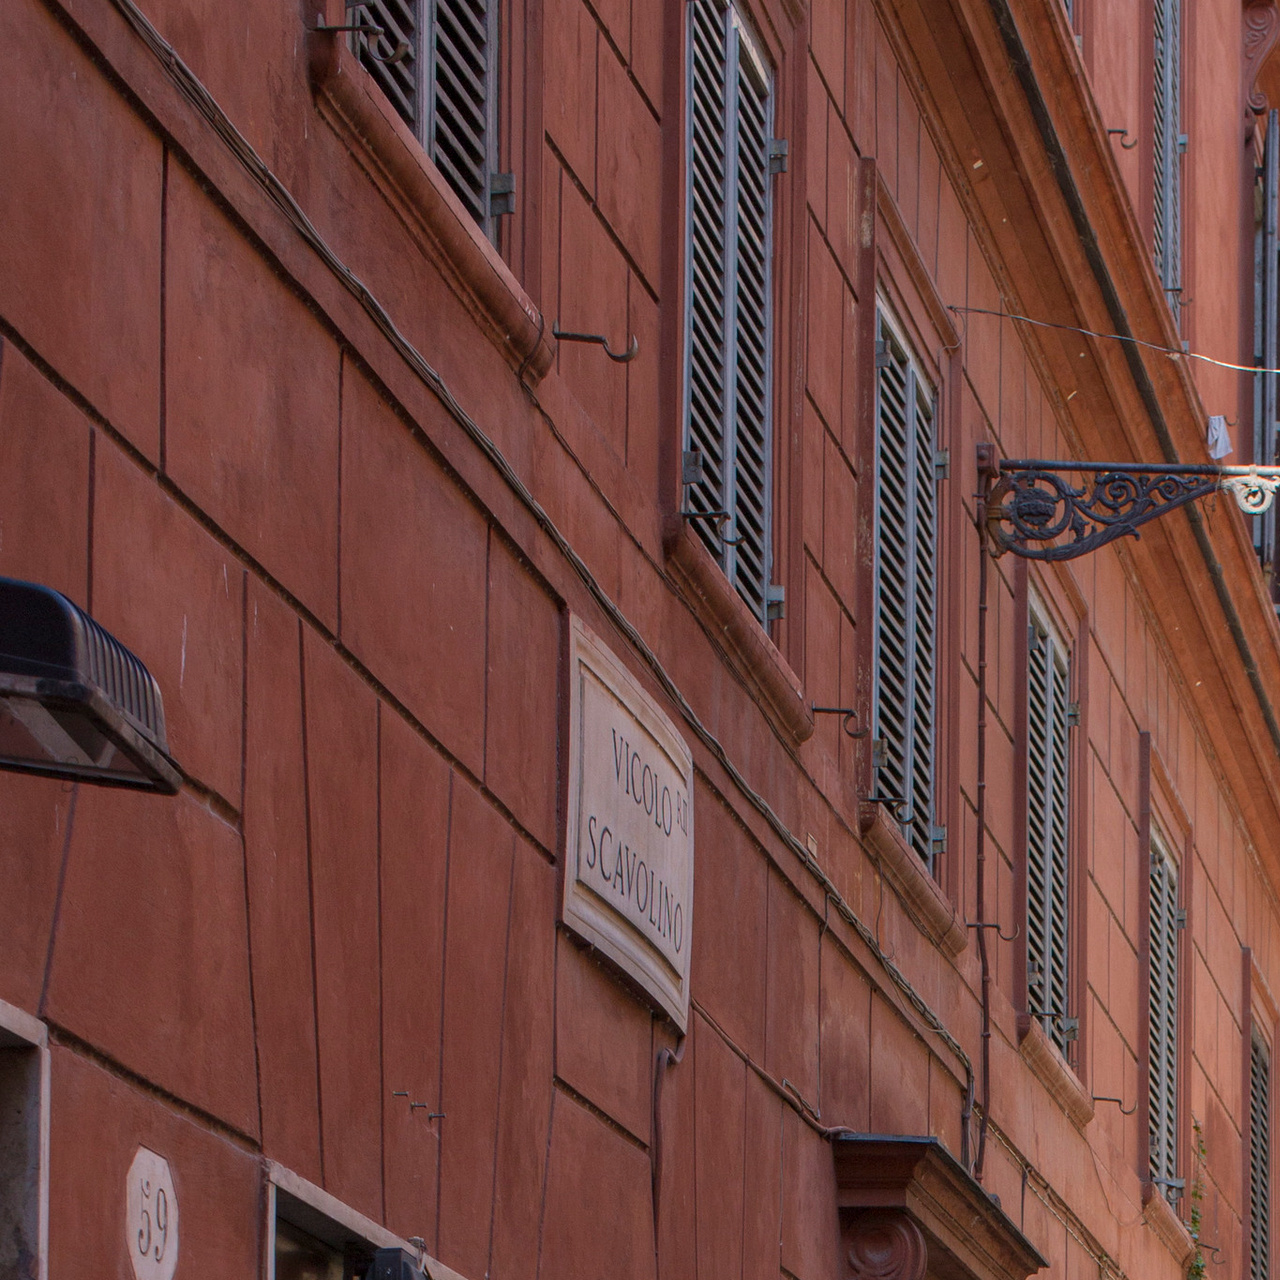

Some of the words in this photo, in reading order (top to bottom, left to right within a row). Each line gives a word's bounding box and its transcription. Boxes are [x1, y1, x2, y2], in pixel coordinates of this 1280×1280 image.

[611, 727, 673, 838] VICOLO
[586, 815, 684, 954] SCAVOLINO
[138, 1177, 168, 1264] 59
